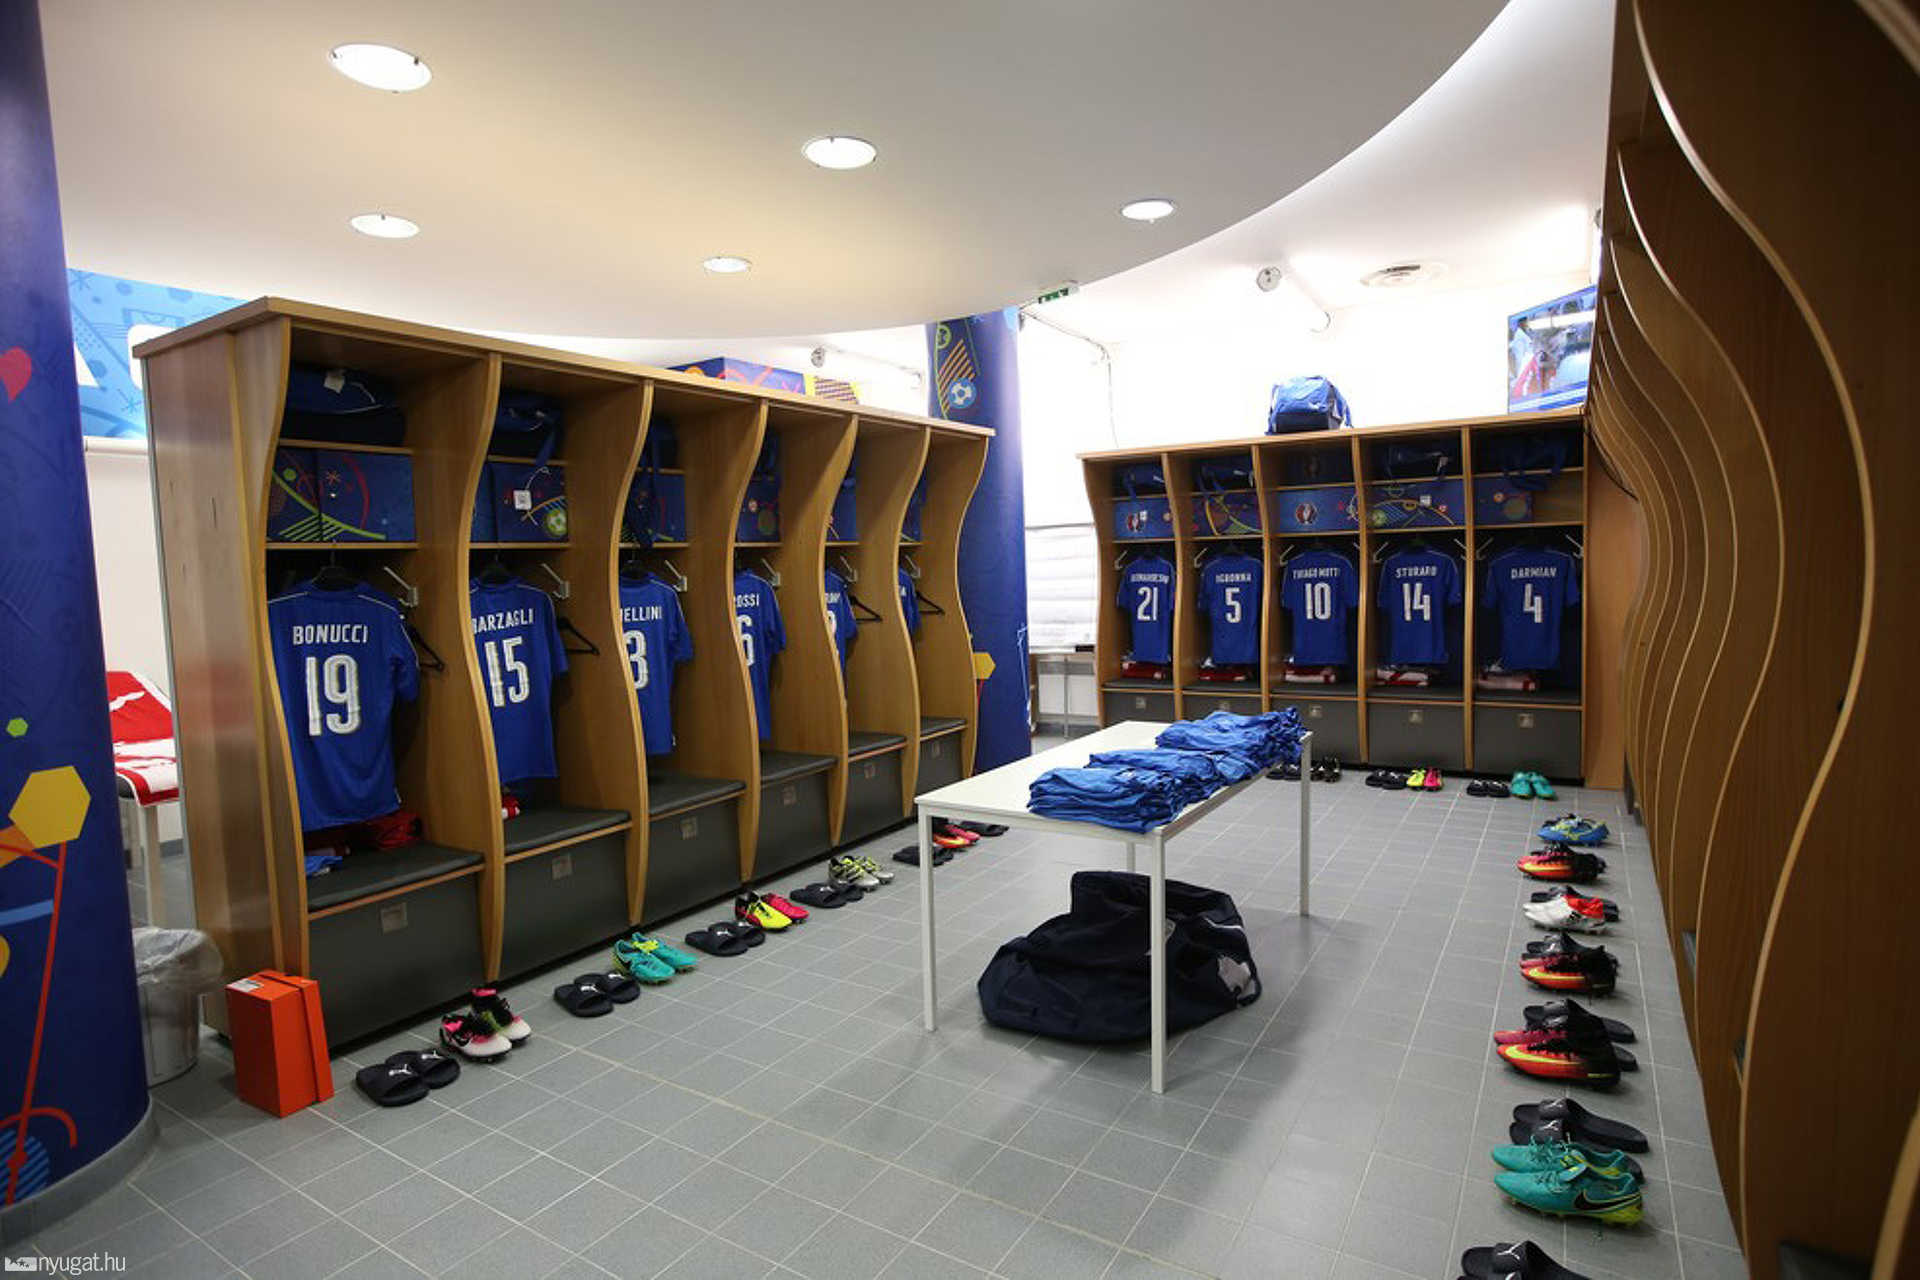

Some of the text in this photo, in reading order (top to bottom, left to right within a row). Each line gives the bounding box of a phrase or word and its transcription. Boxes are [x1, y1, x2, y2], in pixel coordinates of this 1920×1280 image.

[1511, 566, 1557, 579] DARMIAN
[1137, 586, 1158, 621] 21
[1225, 587, 1242, 623] 5
[1305, 582, 1331, 620] 10
[1402, 582, 1431, 621] 14
[1523, 583, 1543, 623] 4
[293, 624, 369, 646] BONUCCI
[484, 635, 531, 708] 15
[305, 653, 363, 737] 19
